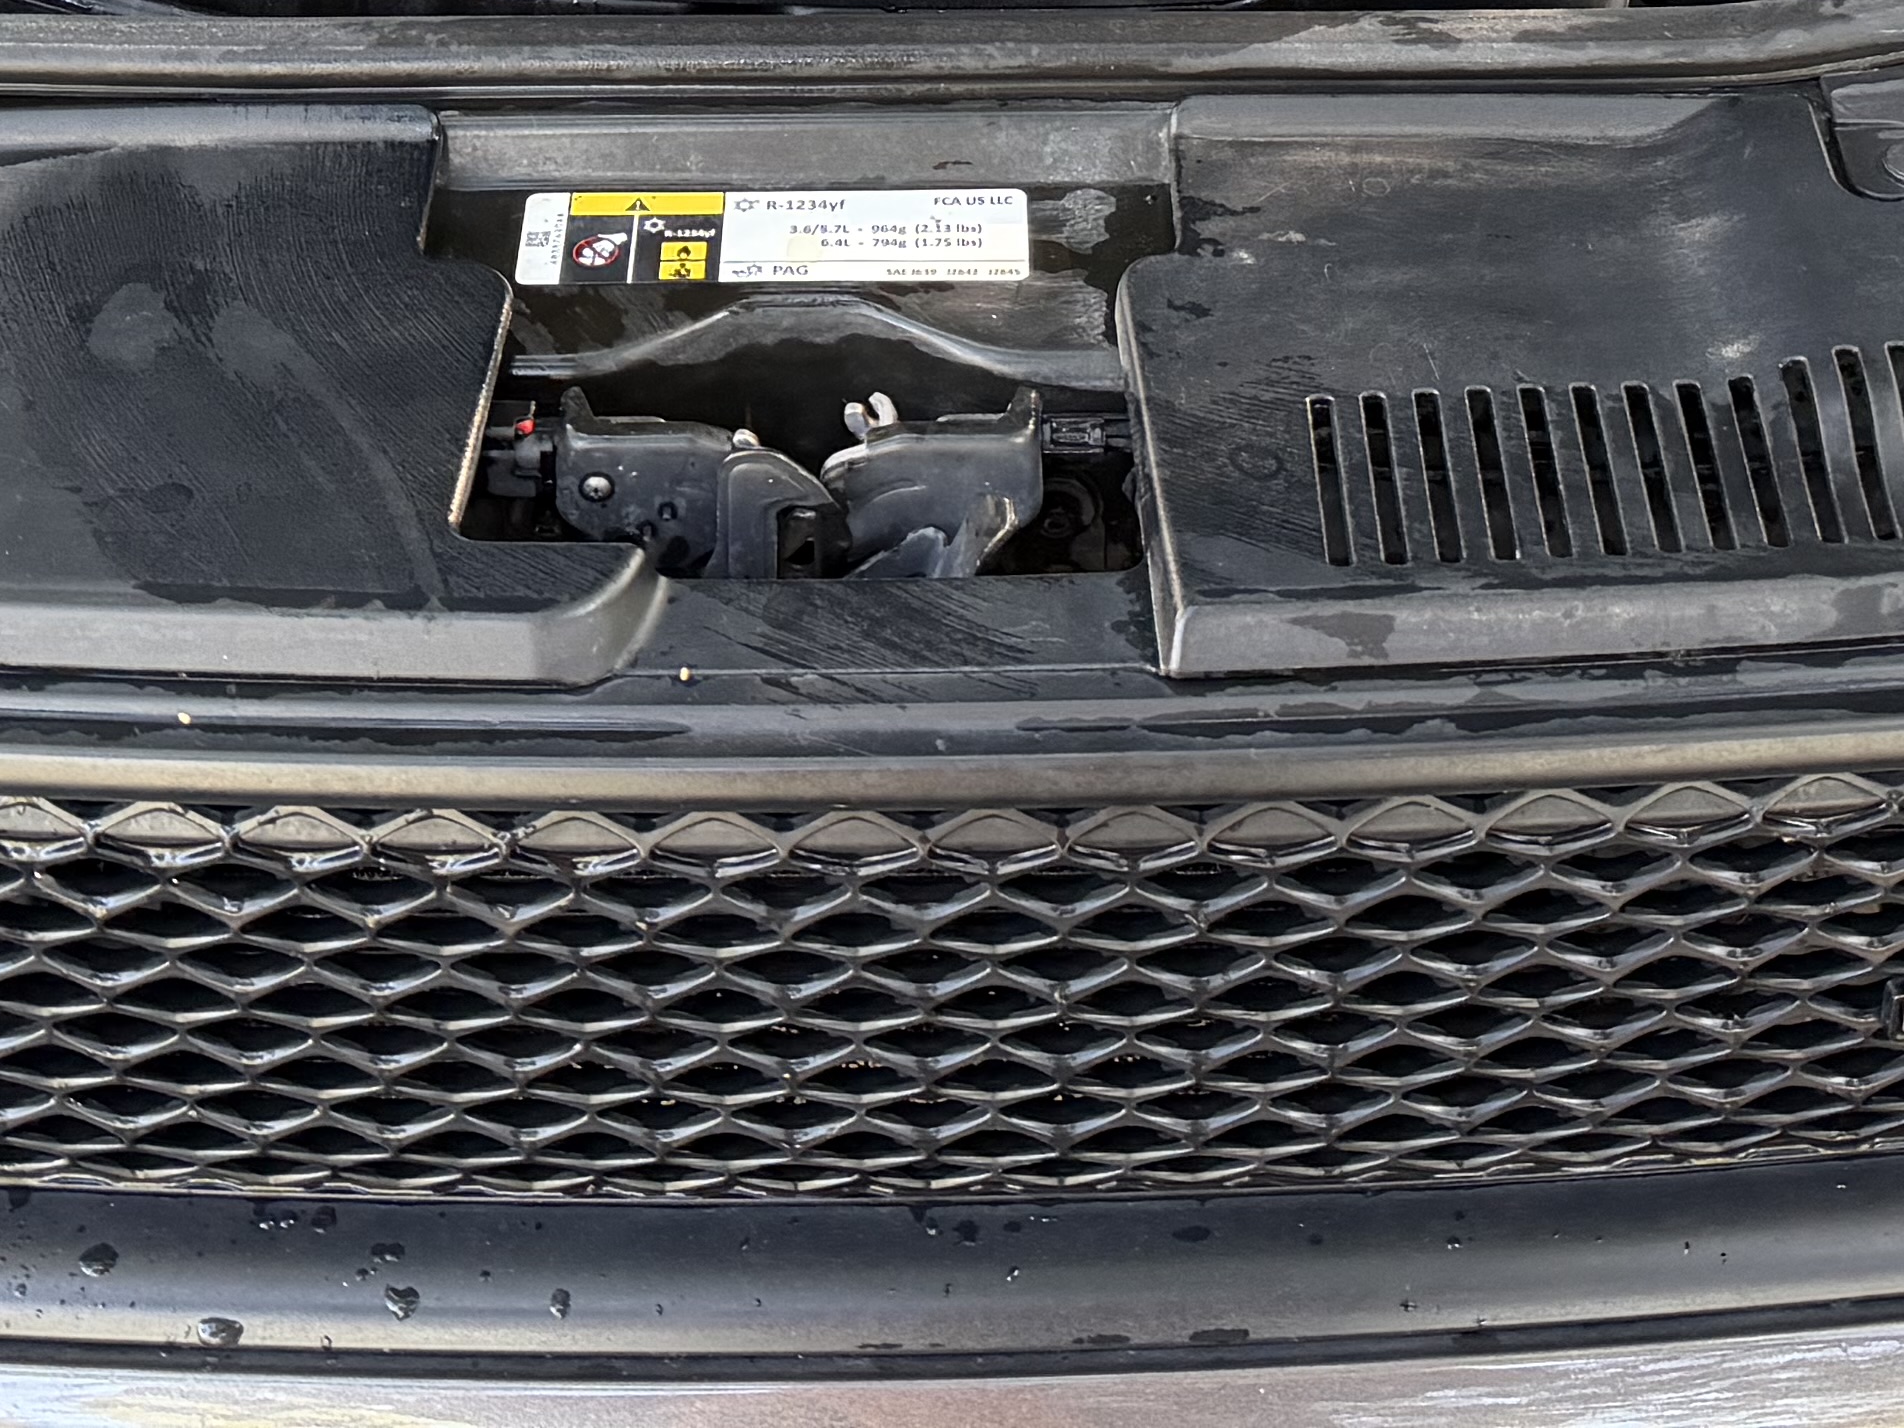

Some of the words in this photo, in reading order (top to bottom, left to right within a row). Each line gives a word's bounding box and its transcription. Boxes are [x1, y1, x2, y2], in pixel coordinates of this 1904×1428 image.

[766, 199, 846, 212] R-1234yf
[934, 196, 962, 206] FCA
[966, 196, 985, 206] US
[990, 196, 1013, 205] LLC
[773, 265, 809, 276] PAG
